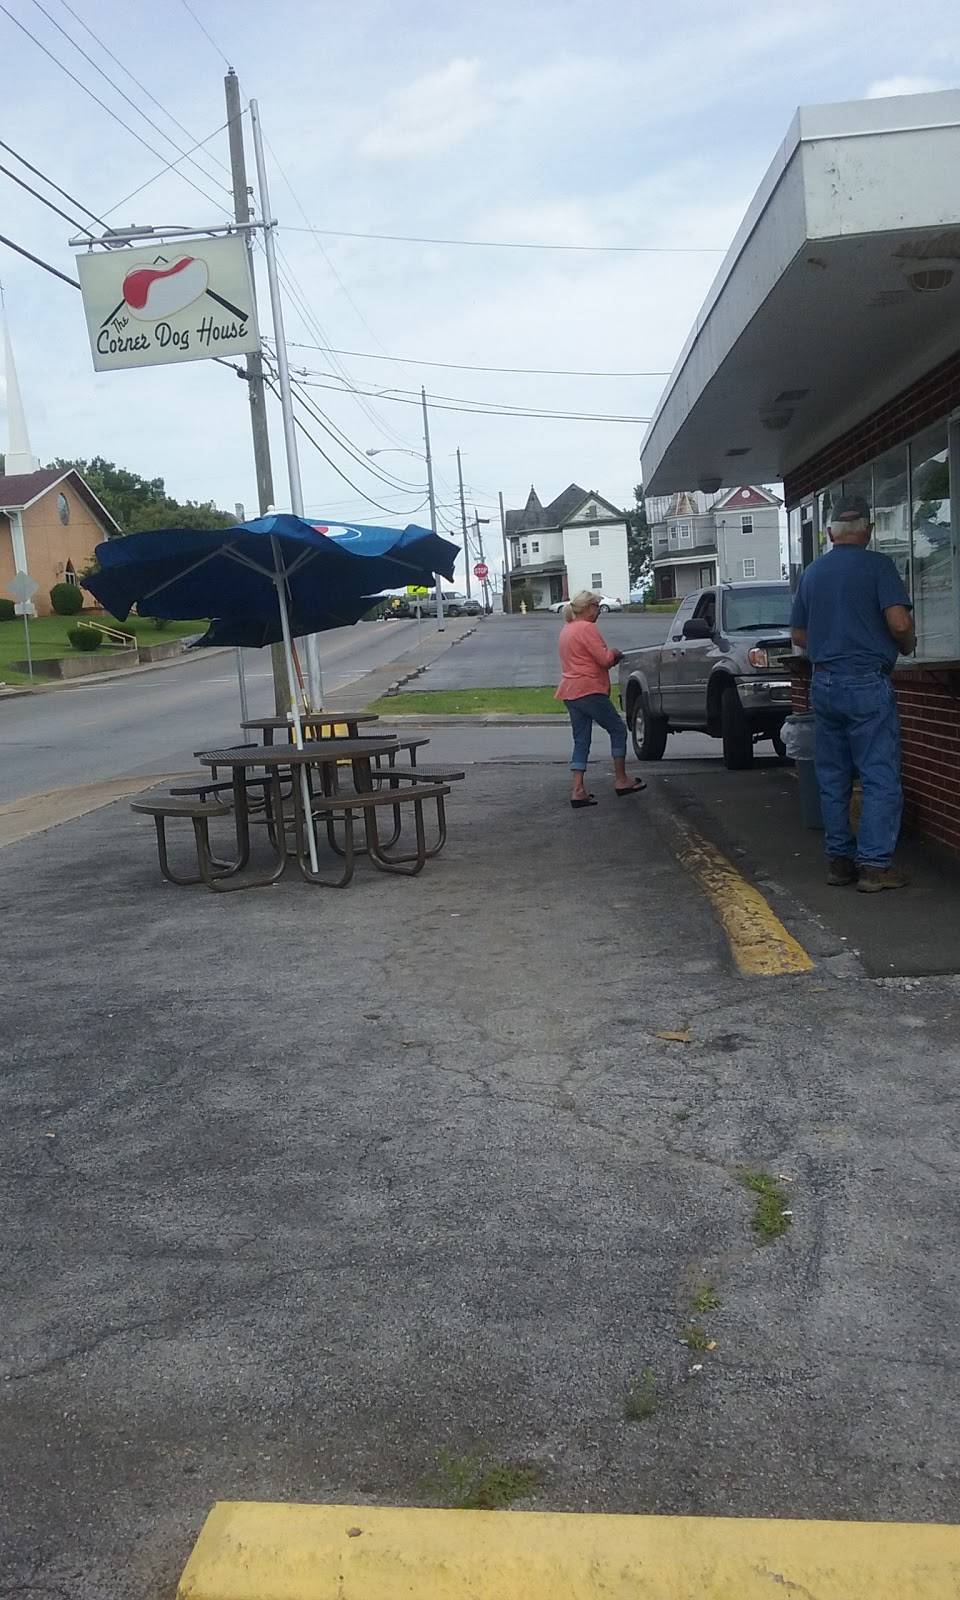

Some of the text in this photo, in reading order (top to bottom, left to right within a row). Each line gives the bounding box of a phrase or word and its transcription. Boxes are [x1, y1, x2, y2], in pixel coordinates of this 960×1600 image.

[111, 316, 129, 334] The
[97, 316, 248, 354] Corner Dog House
[474, 567, 488, 575] STOP
